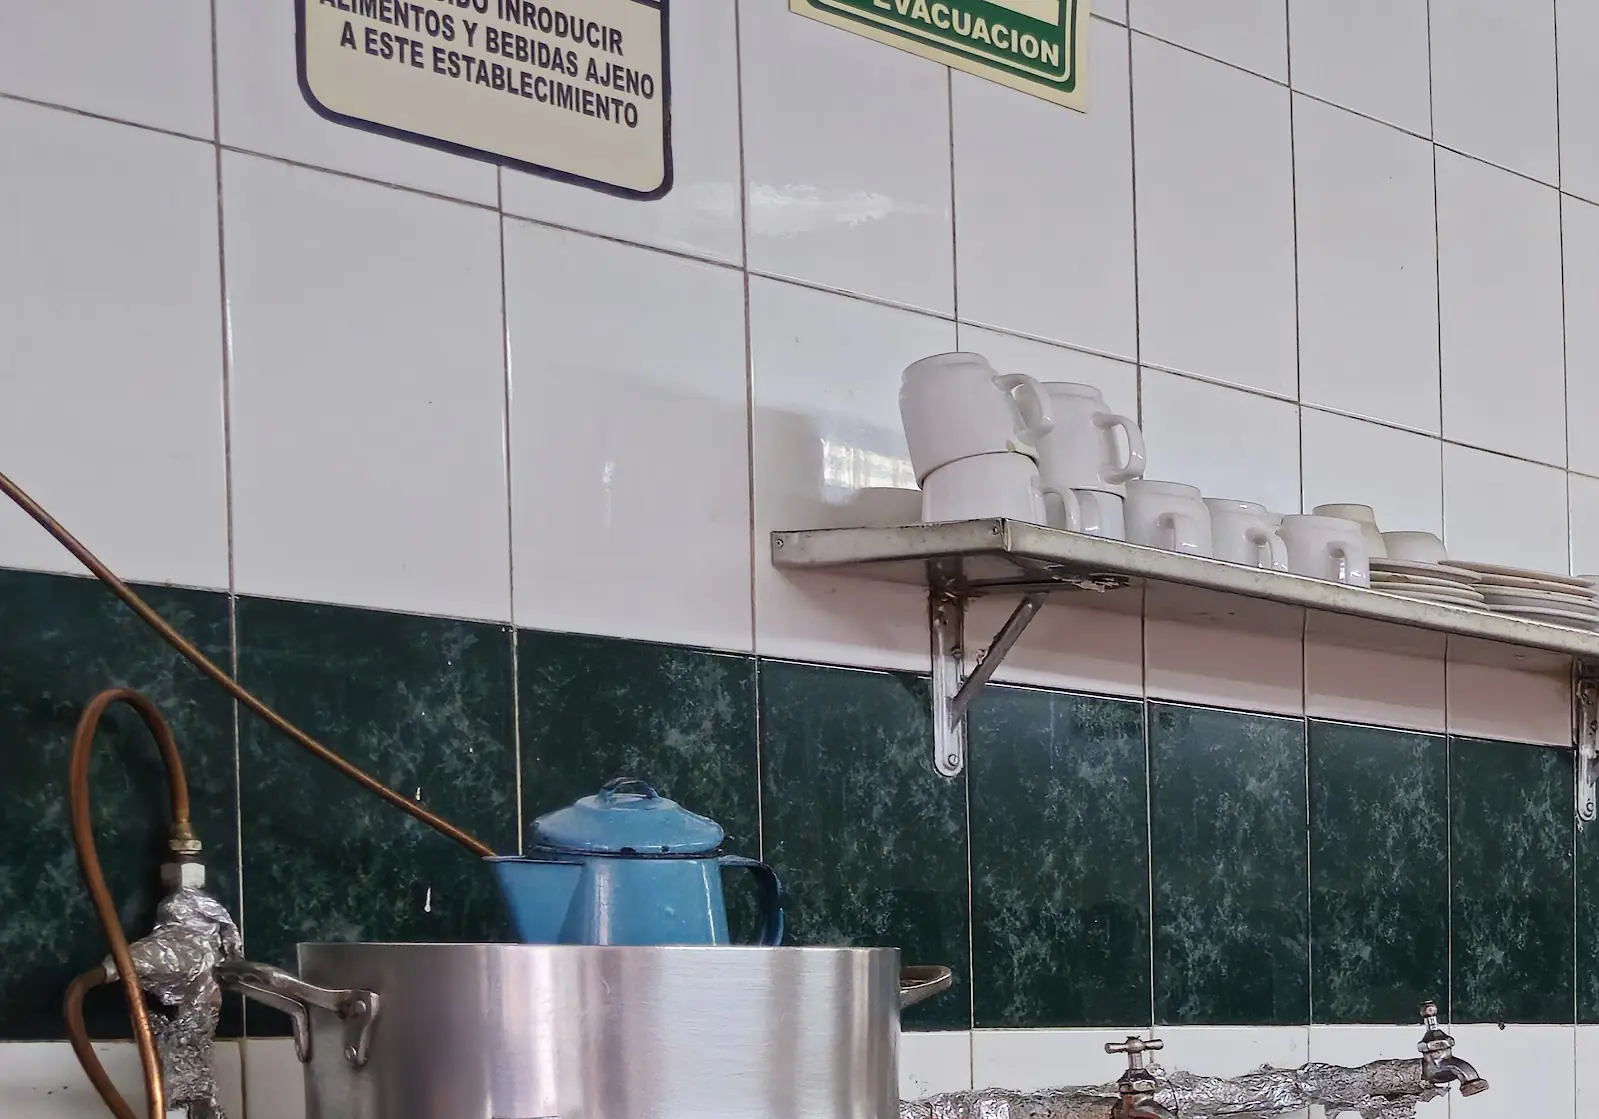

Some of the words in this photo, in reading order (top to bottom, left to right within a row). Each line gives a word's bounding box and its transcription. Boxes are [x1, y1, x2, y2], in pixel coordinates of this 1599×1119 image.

[319, 0, 456, 42] IMENTOS
[462, 19, 478, 48] Y
[486, 26, 578, 78] BEBIDAS
[585, 57, 655, 100] AJENO
[340, 21, 357, 50] A
[364, 26, 424, 70] ESTE
[433, 47, 638, 128] ESTABLECIMIENTO
[498, 0, 623, 57] INRODUCIR
